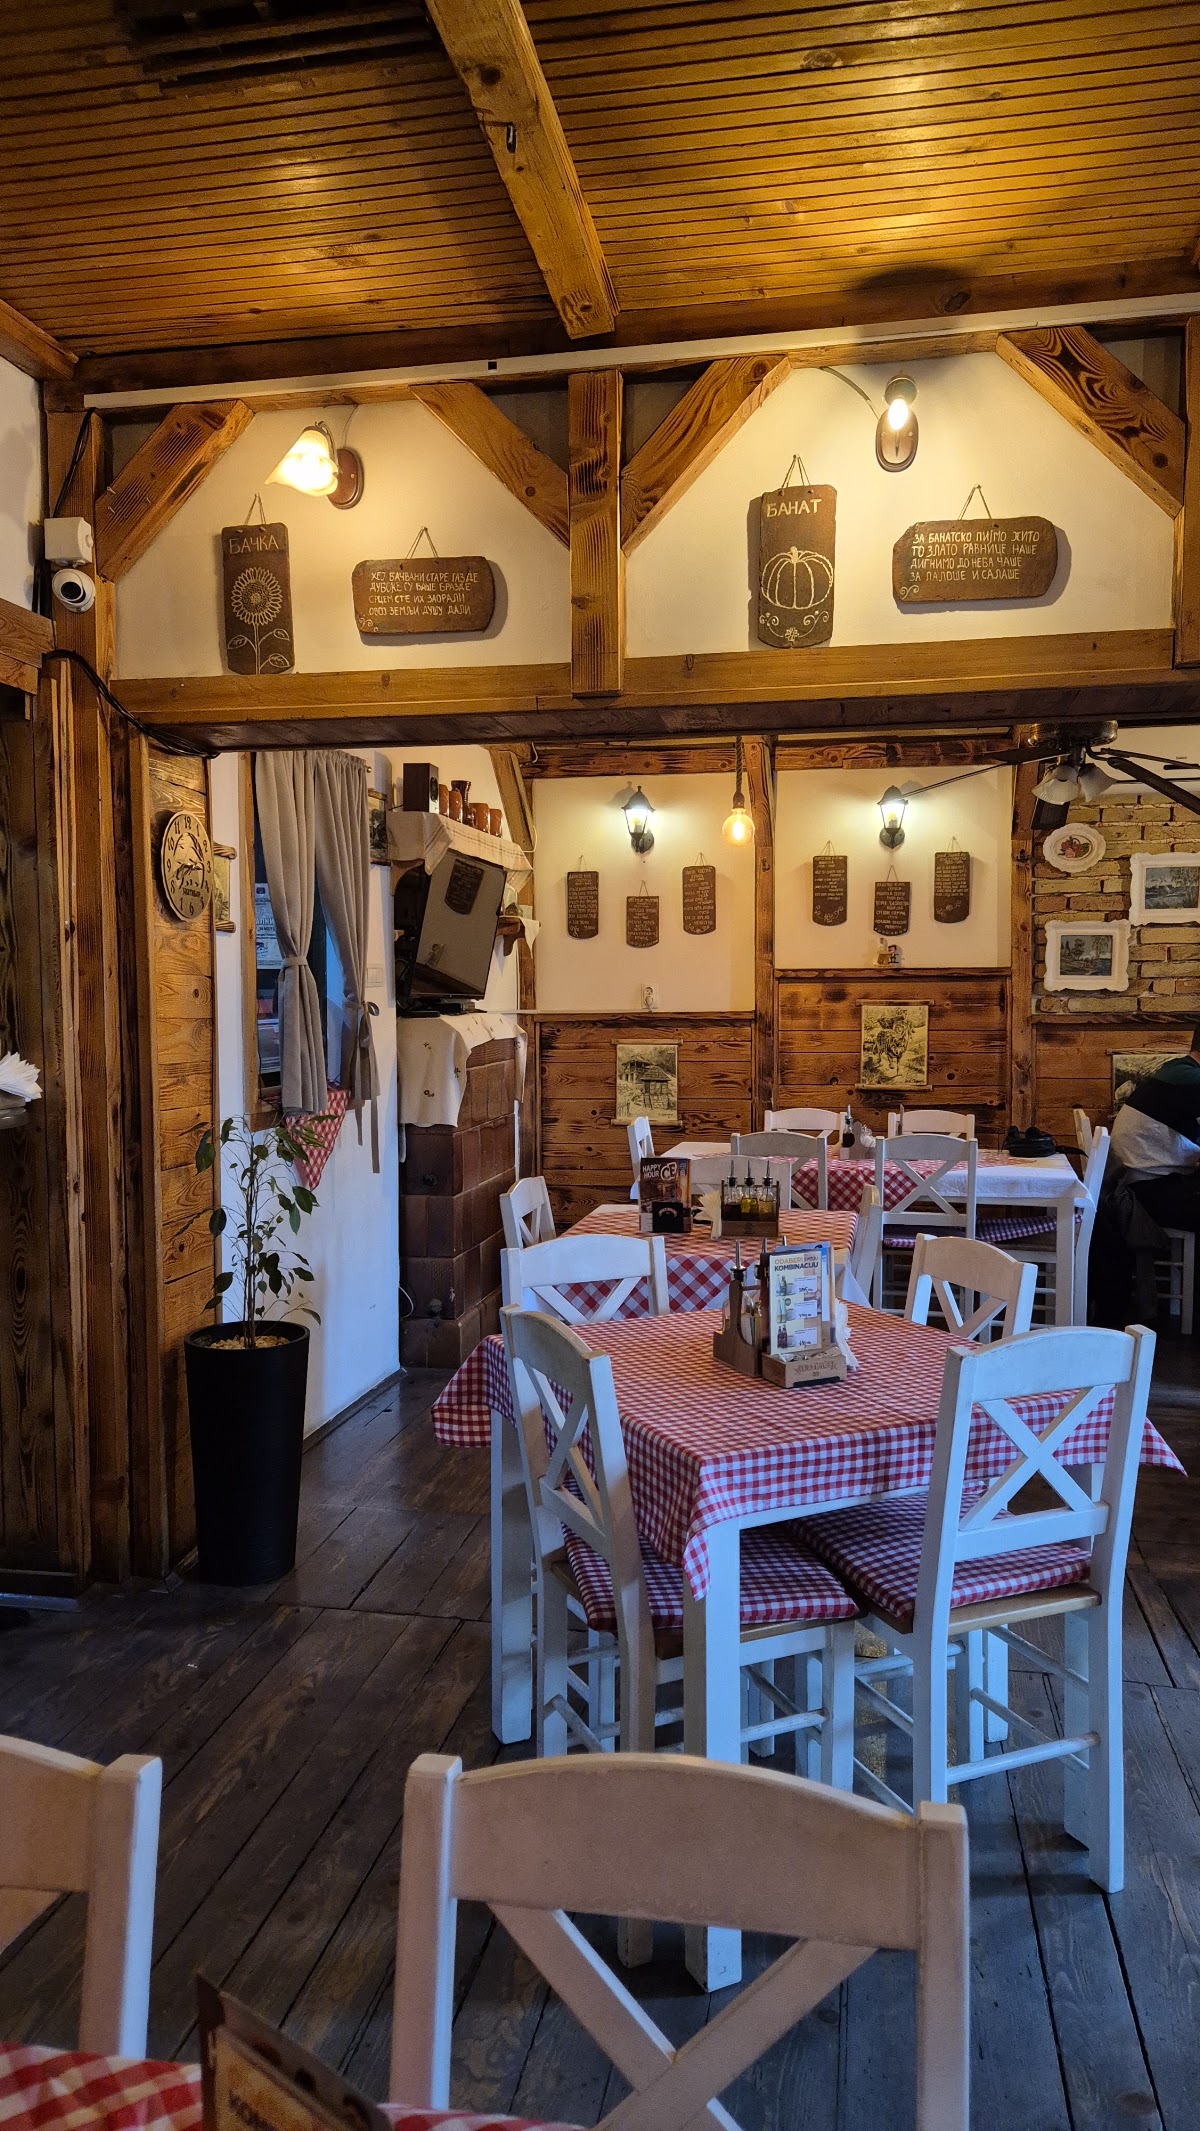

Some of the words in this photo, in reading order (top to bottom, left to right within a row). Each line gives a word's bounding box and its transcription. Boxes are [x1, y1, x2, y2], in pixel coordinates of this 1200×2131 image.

[766, 498, 822, 518] БАНАТ
[229, 534, 279, 554] БАЧКА
[912, 533, 925, 544] ЗА
[928, 531, 972, 544] БАНАТСКО
[976, 530, 1007, 545] ПИЈМО
[1011, 530, 1040, 542] ЖИТО
[911, 545, 925, 557] ТО
[925, 543, 958, 558] ЗЛАТО
[962, 542, 1006, 555] РАВНИЦЕ
[1012, 543, 1037, 555] НАШЕ
[910, 557, 955, 570] ДИГНИМО
[957, 557, 970, 569] ДО
[971, 556, 994, 568] НЕБА
[996, 556, 1022, 567] ЧАШЕ
[371, 571, 386, 582] ХЕЈ
[388, 571, 425, 582] БАЧВАНИ
[426, 572, 450, 582] СТАРЕ
[452, 572, 479, 583] ГАЗДЕ
[910, 571, 921, 582] ЗА
[971, 570, 980, 580] И
[981, 568, 1020, 580] САЛАШЕ
[369, 581, 402, 593] ДУБОКЕ
[403, 581, 413, 591] СУ
[439, 581, 471, 592] БРАЗДЕ
[394, 594, 410, 603] СТЕ
[413, 594, 425, 603] ИХ
[426, 592, 465, 603] ЗАОРАЛИ
[422, 605, 443, 616] ДУШУ
[447, 604, 471, 615] ДАЛИ
[174, 820, 181, 835] 11
[184, 816, 192, 830] 12
[167, 837, 175, 851] 10
[203, 839, 208, 853] 2
[166, 858, 172, 873] 9
[207, 861, 212, 874] 3
[170, 879, 176, 894] 8
[642, 1164, 662, 1173] HAPPY
[643, 1170, 660, 1179] HOUR
[774, 1256, 803, 1265] ODABERI
[774, 1262, 819, 1272] KOMBINACIJU
